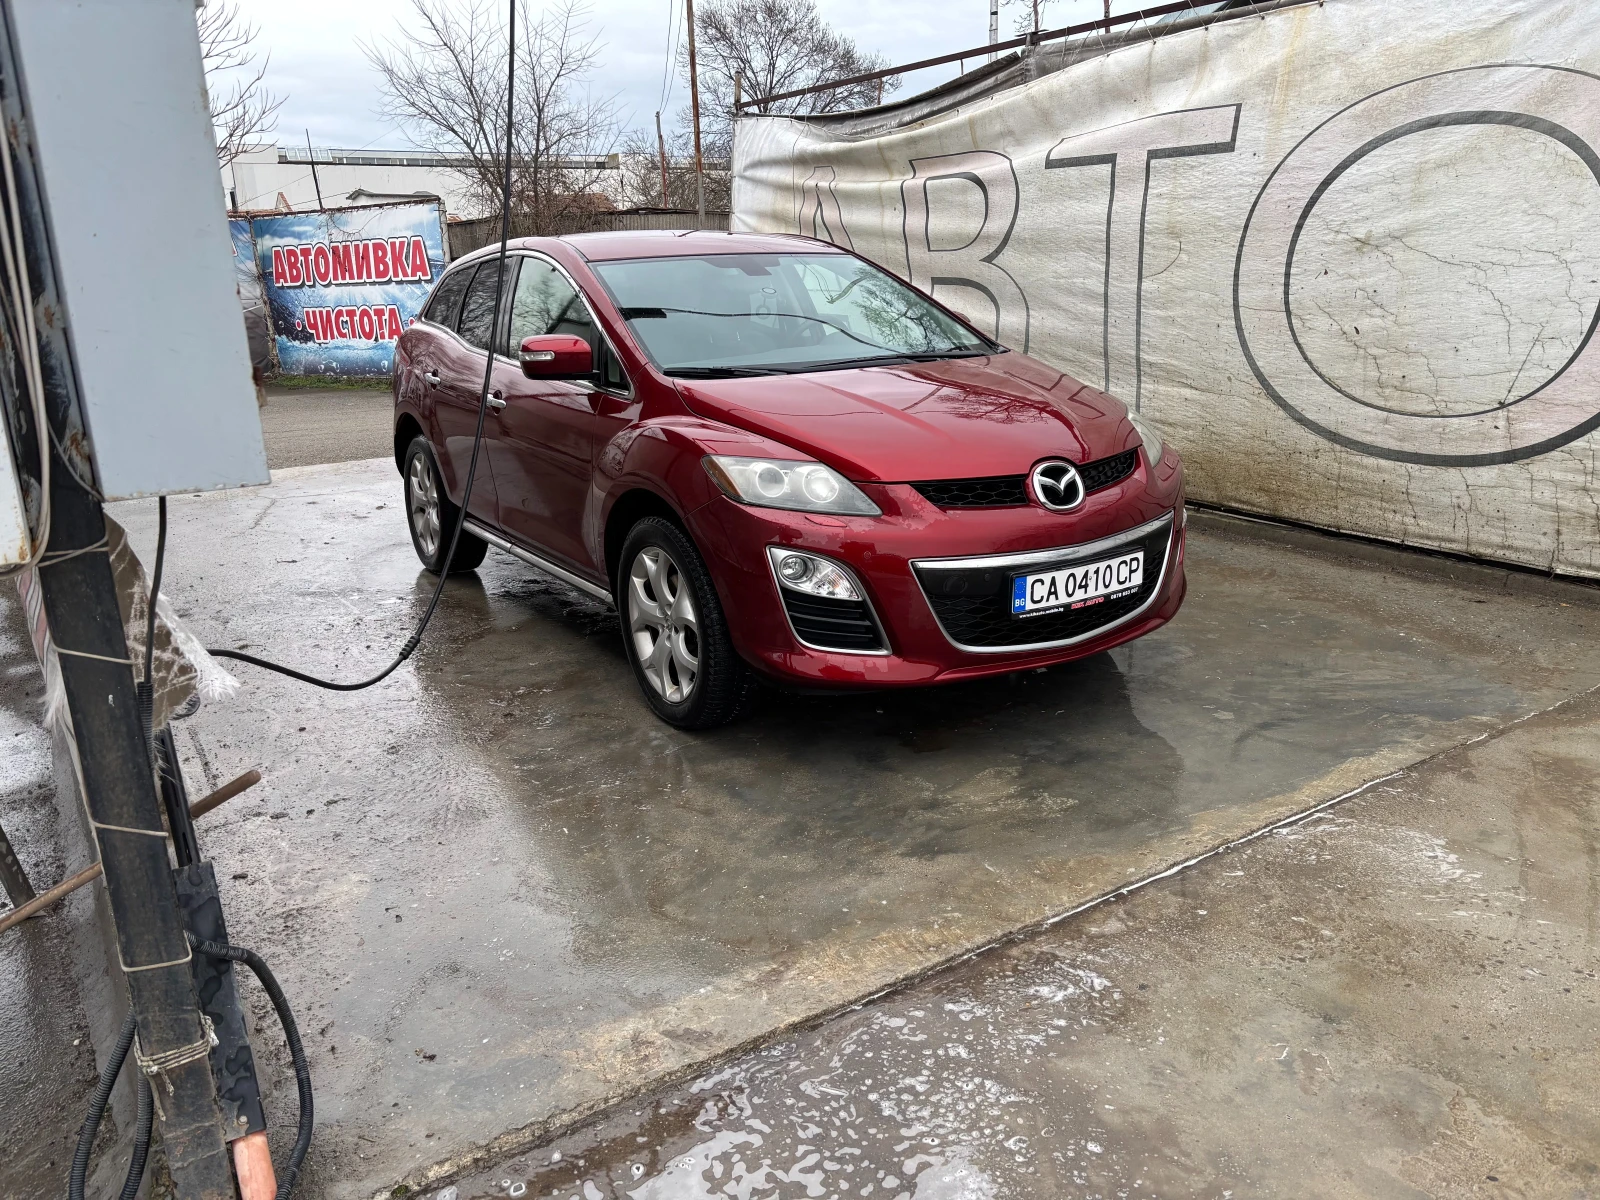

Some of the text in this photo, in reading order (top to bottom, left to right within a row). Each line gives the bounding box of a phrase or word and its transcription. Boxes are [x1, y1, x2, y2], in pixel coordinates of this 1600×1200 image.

[272, 236, 432, 287] АВТОМИВКА
[304, 305, 402, 343] ЧИСТОТА
[1030, 556, 1140, 604] CA 0410 CP
[1014, 598, 1025, 607] BG
